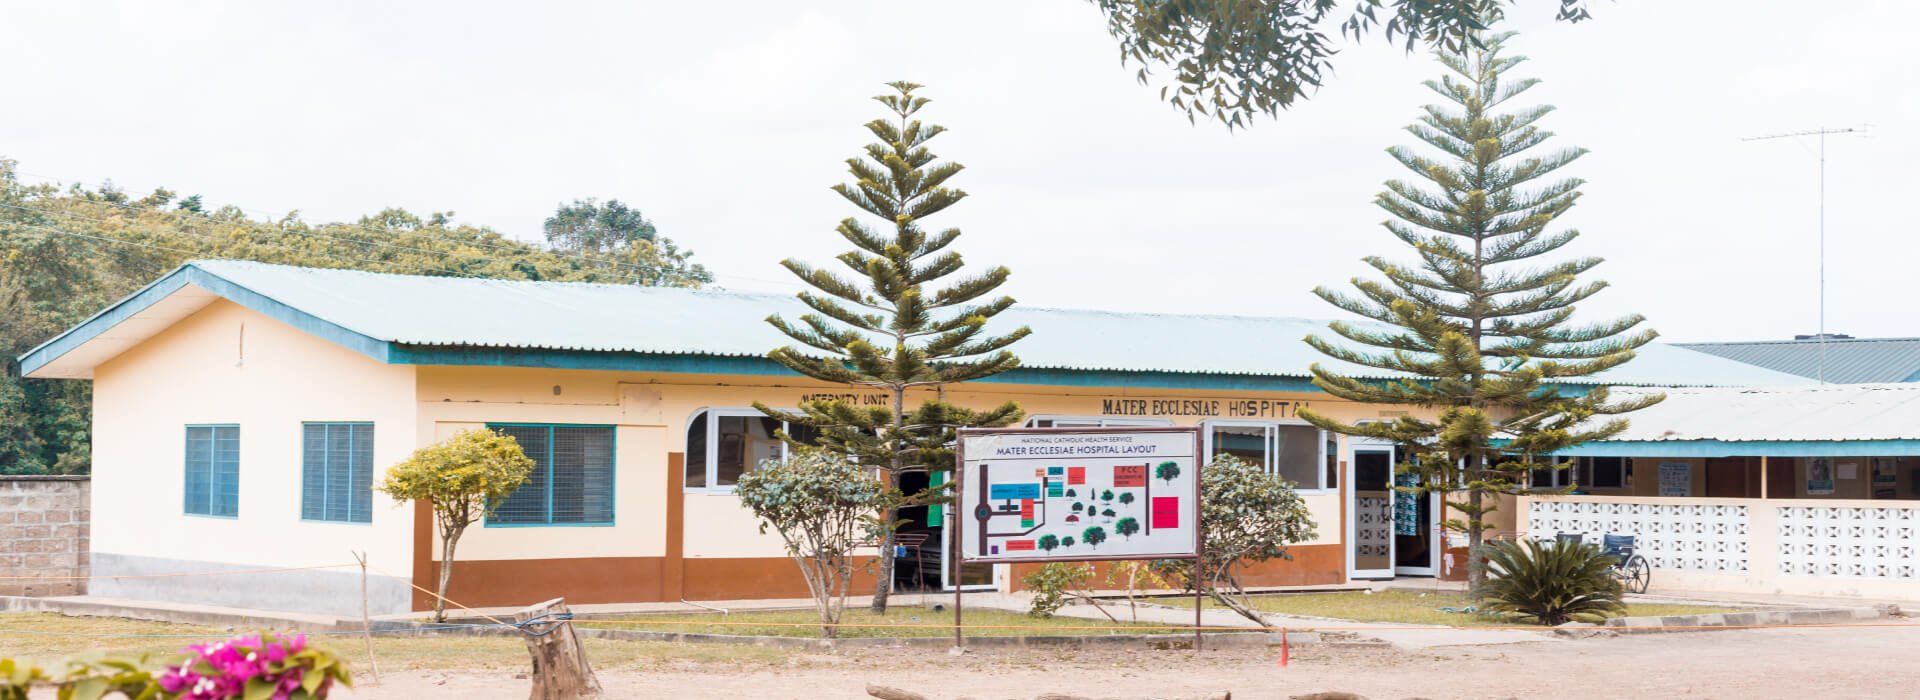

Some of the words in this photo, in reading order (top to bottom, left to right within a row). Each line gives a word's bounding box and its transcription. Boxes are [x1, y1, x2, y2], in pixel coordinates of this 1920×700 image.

[864, 393, 889, 405] UNIT
[1102, 399, 1147, 416] MATER
[1152, 400, 1219, 416] ECCLESIAE
[997, 447, 1026, 455] MATER
[1029, 446, 1074, 455] ECCLESIAE
[1077, 445, 1119, 454] HOSPITAL
[1122, 445, 1157, 453] LAYOUT
